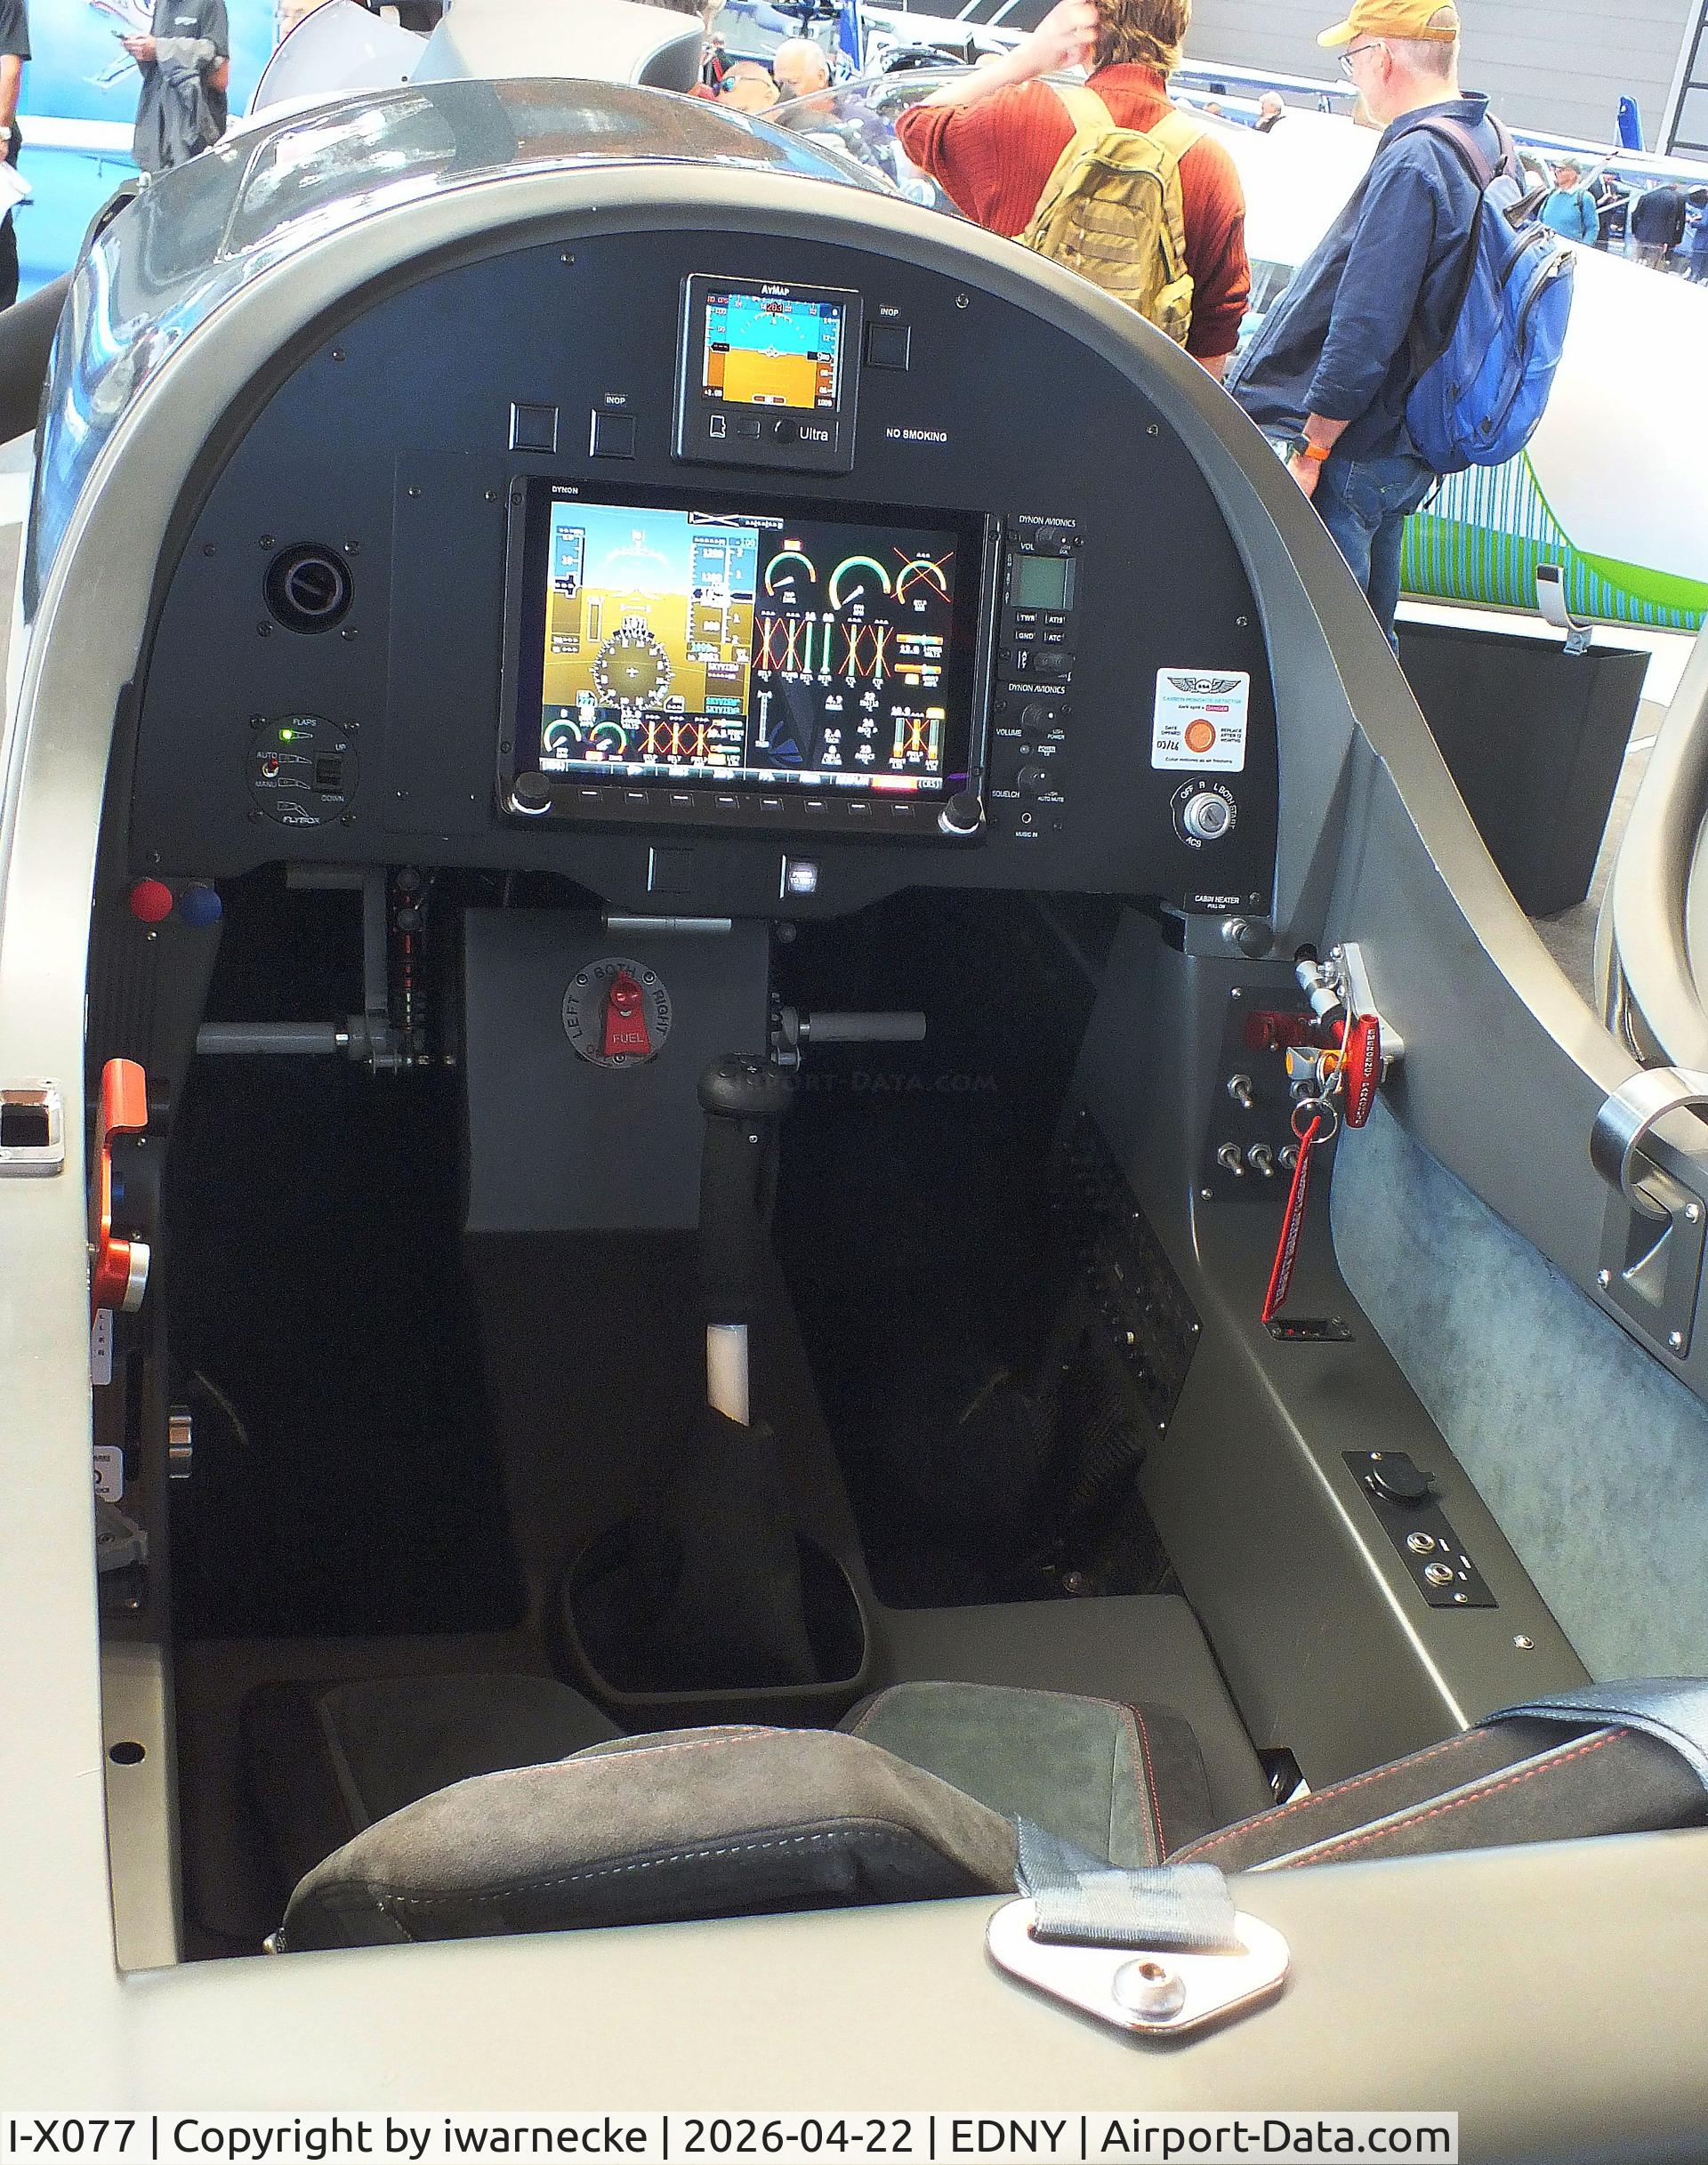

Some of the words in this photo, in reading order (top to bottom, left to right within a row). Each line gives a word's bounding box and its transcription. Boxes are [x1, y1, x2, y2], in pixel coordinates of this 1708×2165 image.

[880, 307, 899, 317] INOP
[606, 396, 625, 406] INOP
[800, 427, 829, 442] Ultra
[886, 428, 900, 439] NO
[902, 430, 947, 443] SMOKING
[552, 485, 578, 495] DYNON
[1019, 515, 1044, 526] DYNON
[1044, 519, 1076, 528] AVIONICS
[1020, 542, 1035, 551] VOL
[1048, 633, 1061, 642] ATC
[1008, 683, 1033, 693] DYNON
[1034, 685, 1066, 695] AVIONICS
[293, 719, 318, 727] FLAPS
[996, 728, 1022, 737] VOLUME
[335, 743, 347, 751] UP
[256, 752, 278, 760] AUTO
[321, 794, 344, 803] DOWN
[992, 790, 1020, 799] SQUELCH
[1180, 785, 1193, 799] OFF
[1213, 783, 1218, 792] L
[1218, 785, 1235, 805] BOTH
[1185, 837, 1202, 848] ACS
[1195, 895, 1214, 903] CABIN
[1214, 896, 1240, 905] HEATER
[568, 994, 583, 1039] LEFT
[653, 989, 669, 1033] RIGHT
[612, 1033, 644, 1043] FUEL
[1363, 1028, 1375, 1077] EMERGENCY
